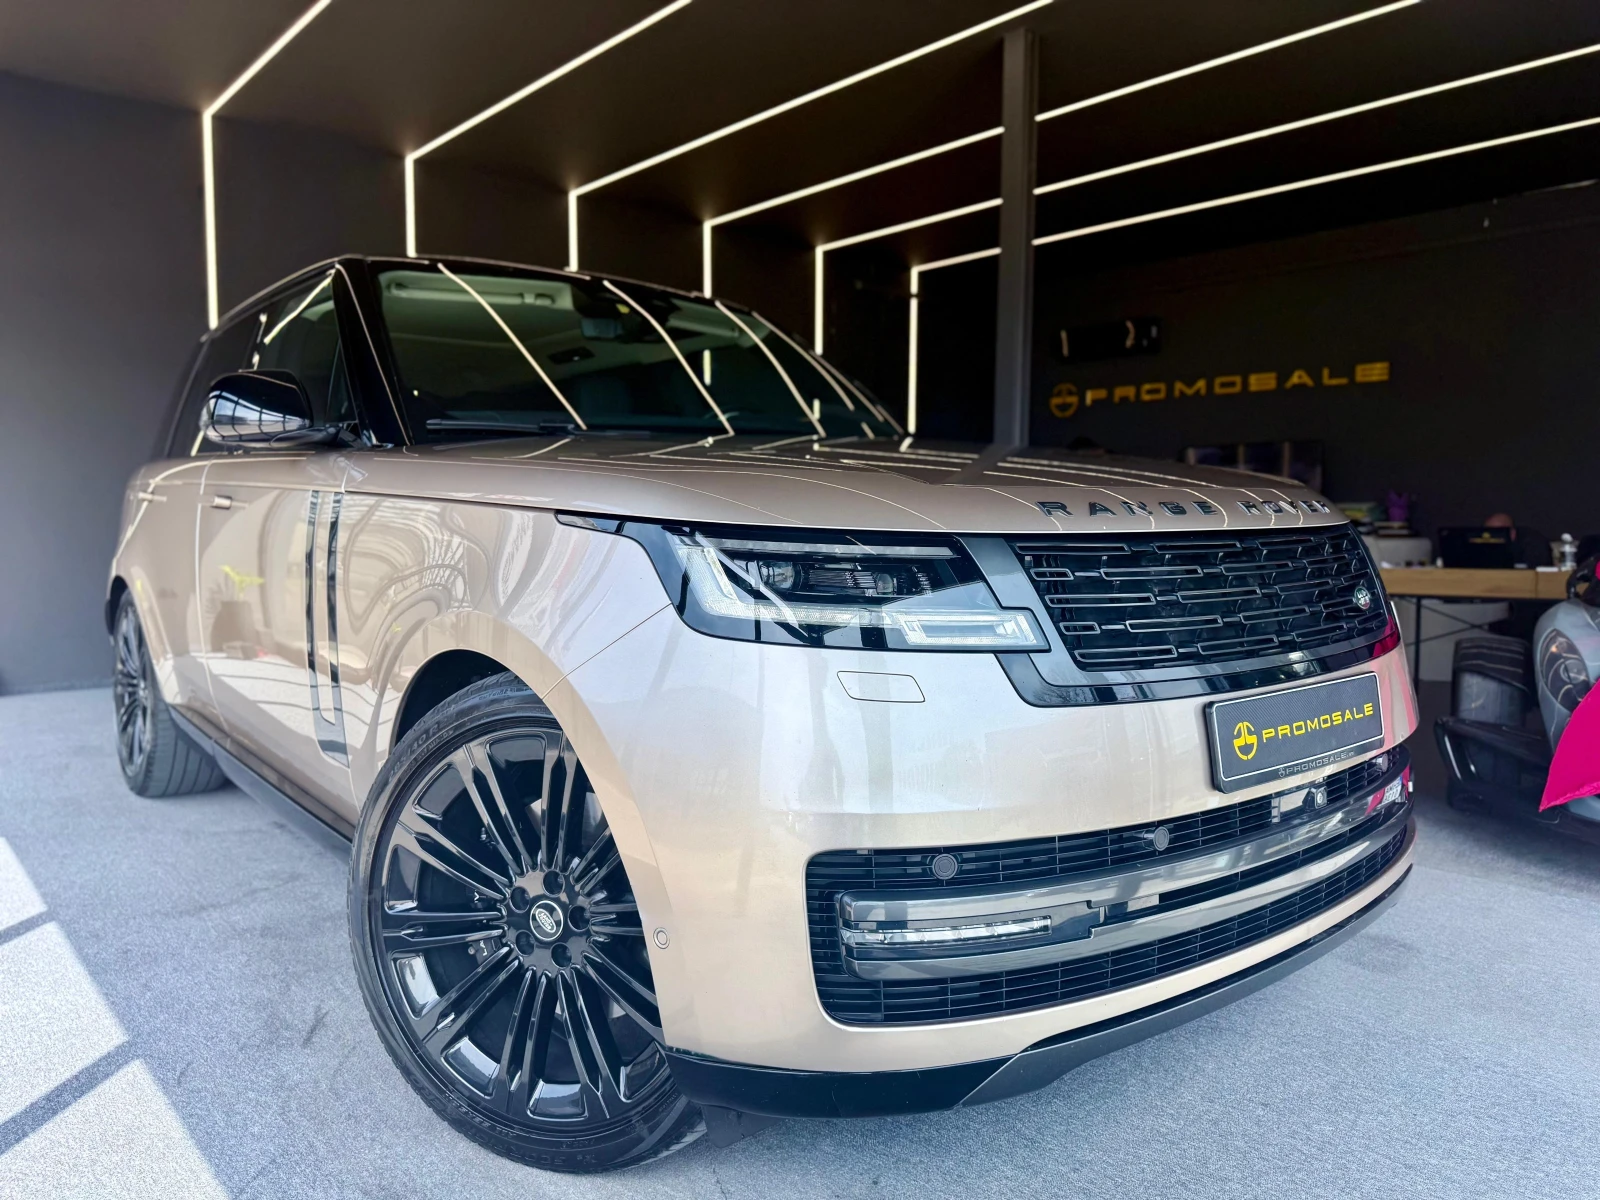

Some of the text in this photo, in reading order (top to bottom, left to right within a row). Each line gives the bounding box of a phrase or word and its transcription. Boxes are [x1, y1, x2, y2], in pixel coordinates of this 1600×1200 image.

[1085, 361, 1391, 407] PROMOSALE
[1036, 500, 1331, 517] RANGE ROVER
[1262, 702, 1374, 743] PROMOSALE
